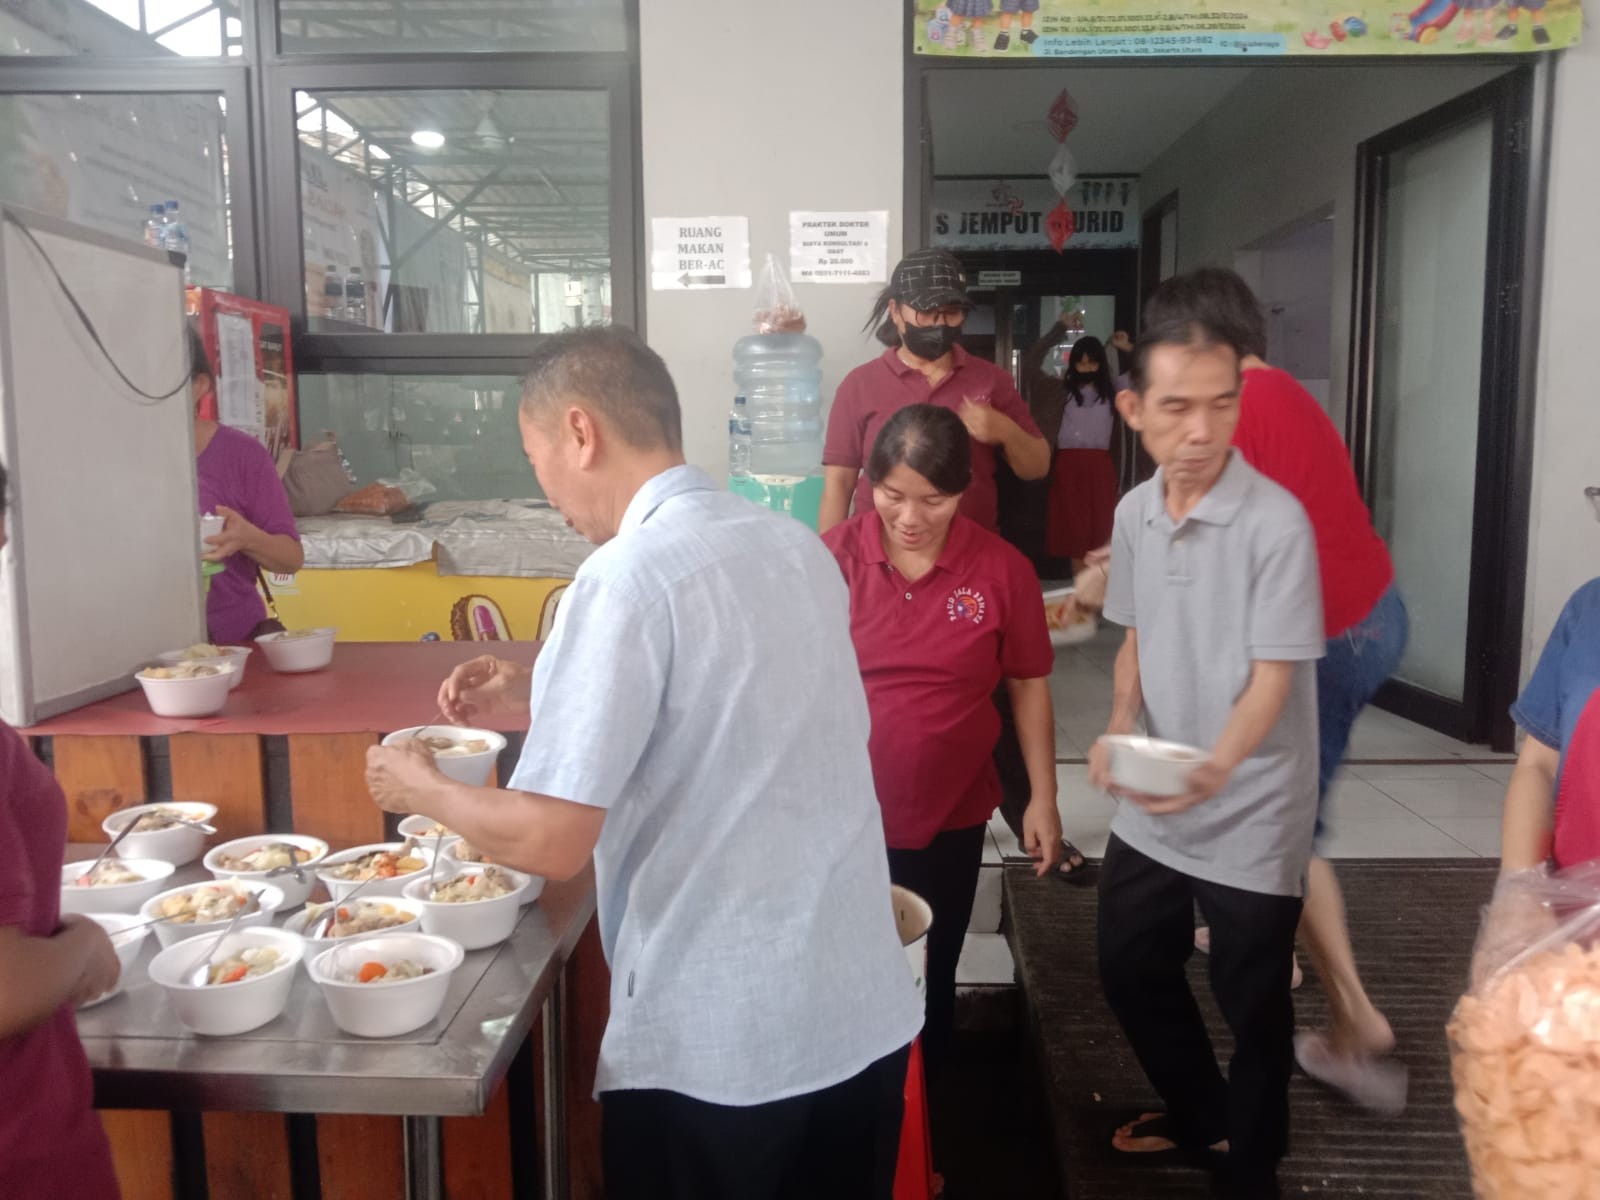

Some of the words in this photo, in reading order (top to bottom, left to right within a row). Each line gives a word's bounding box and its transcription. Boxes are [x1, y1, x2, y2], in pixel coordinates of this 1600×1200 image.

[1044, 38, 1063, 46] Info
[1095, 39, 1125, 47] Lanjut
[959, 211, 1042, 235] JEMPUT
[1056, 210, 1124, 234] URID
[679, 226, 722, 238] RUANG
[678, 243, 724, 255] MAKAN
[679, 259, 725, 271] BER-AC
[818, 258, 828, 266] Rp
